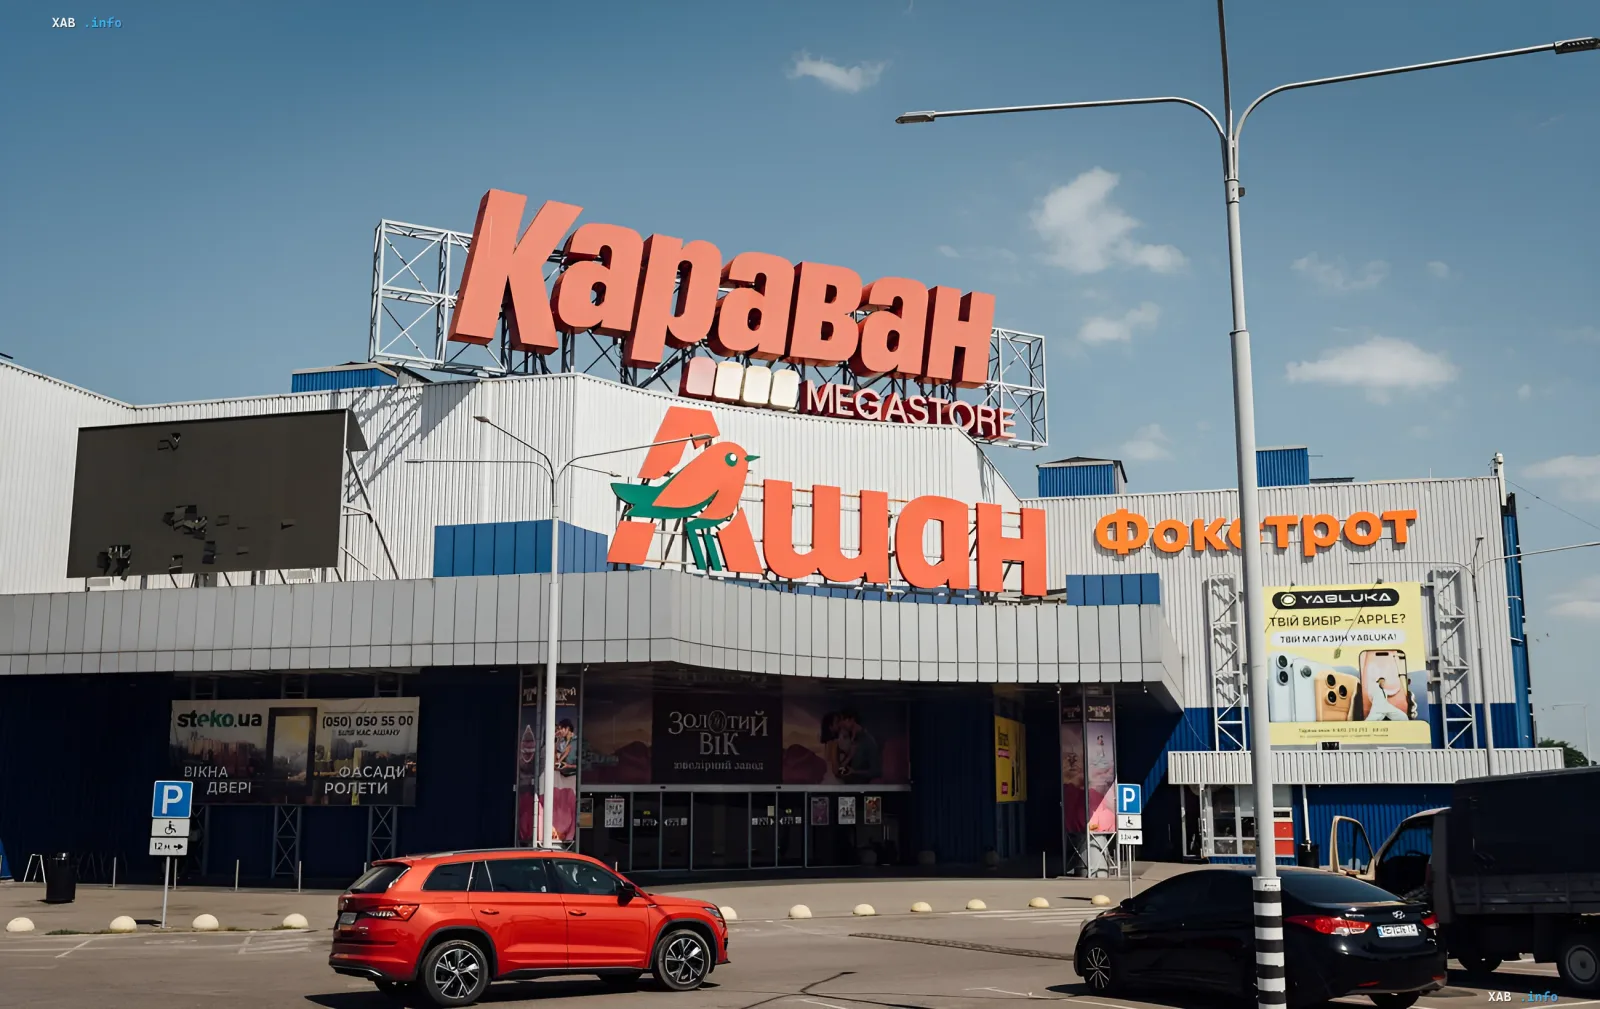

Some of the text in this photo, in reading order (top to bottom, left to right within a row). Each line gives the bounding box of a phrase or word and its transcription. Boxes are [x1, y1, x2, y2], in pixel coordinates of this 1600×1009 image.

[447, 188, 996, 389] Караван
[803, 379, 1017, 441] MEGASTORE
[606, 405, 1048, 597] Ашан
[1301, 592, 1392, 604] YABLUKA
[1270, 614, 1299, 627] ТВІЙ
[1303, 615, 1341, 626] ВИБІР
[1357, 613, 1406, 625] APPLE?
[1302, 634, 1348, 643] МАГАЗИН
[177, 709, 263, 728] steko.ua
[322, 715, 413, 729] (050) 050 55 00
[184, 766, 228, 778] ВІКНА
[338, 765, 406, 779] ФАСАДИ
[206, 781, 252, 795] ДВЕРІ
[324, 782, 388, 795] РОЛЕТИ
